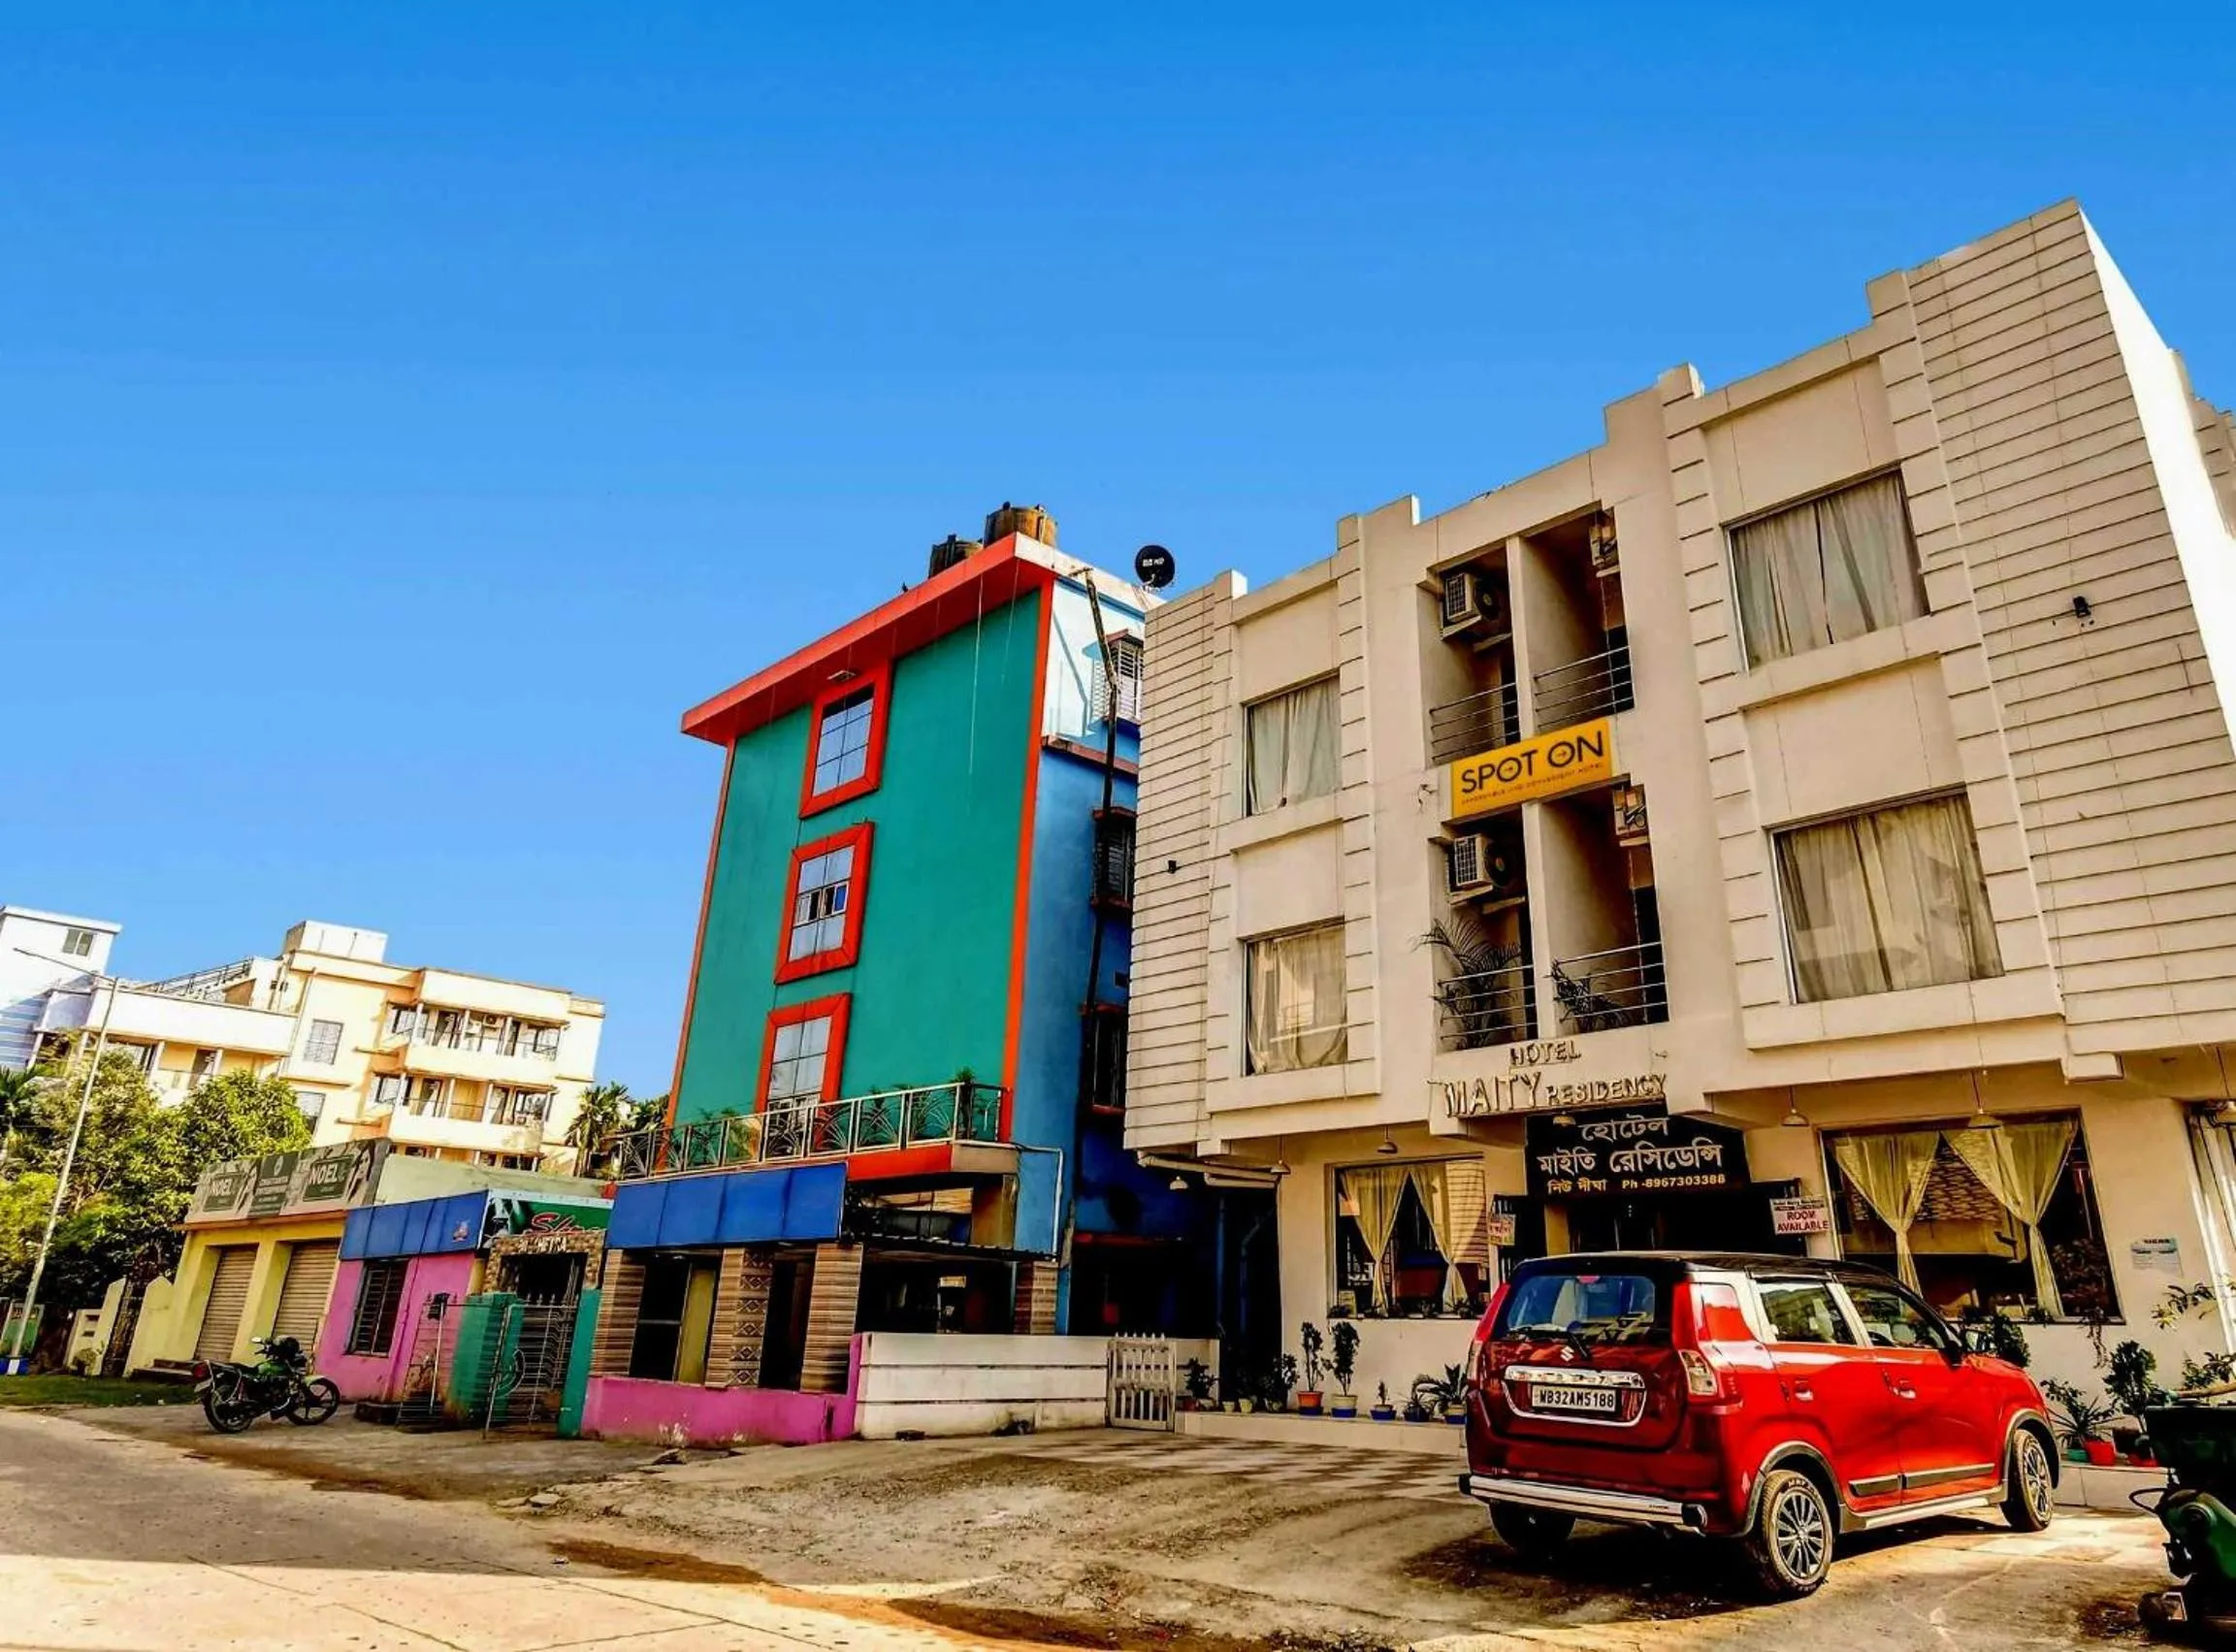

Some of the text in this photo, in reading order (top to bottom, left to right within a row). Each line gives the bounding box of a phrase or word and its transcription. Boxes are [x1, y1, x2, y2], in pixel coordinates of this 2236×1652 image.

[1461, 749, 1539, 794] SPOT
[1547, 730, 1604, 767] ON
[1509, 1040, 1581, 1066] HOTEL
[1544, 1073, 1668, 1105] RESIDENCY
[1577, 1114, 1670, 1143] হোটেল
[1537, 1146, 1598, 1177] মাইতি
[1622, 1179, 1638, 1190] Ph
[1777, 1219, 1830, 1232] AVAILABLE
[1786, 1210, 1816, 1221] ROOM
[1538, 1389, 1615, 1409] WB32AM5188
